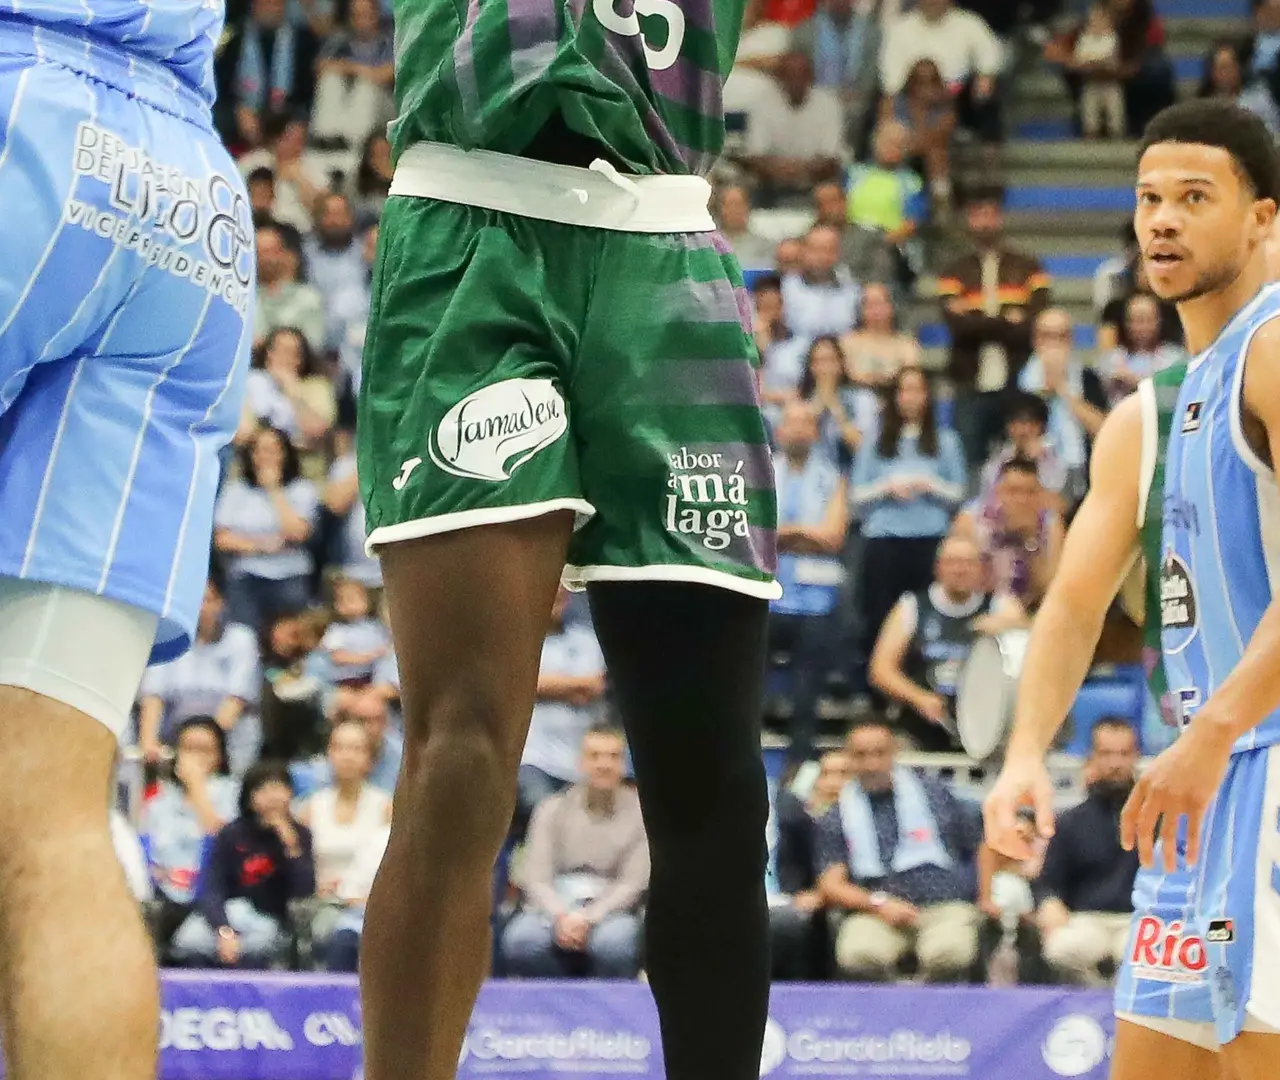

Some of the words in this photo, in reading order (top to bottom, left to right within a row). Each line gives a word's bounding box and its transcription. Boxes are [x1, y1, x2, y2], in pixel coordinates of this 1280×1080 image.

[665, 494, 751, 550] laga
[1131, 916, 1209, 972] Río
[159, 1007, 295, 1052] EGA
